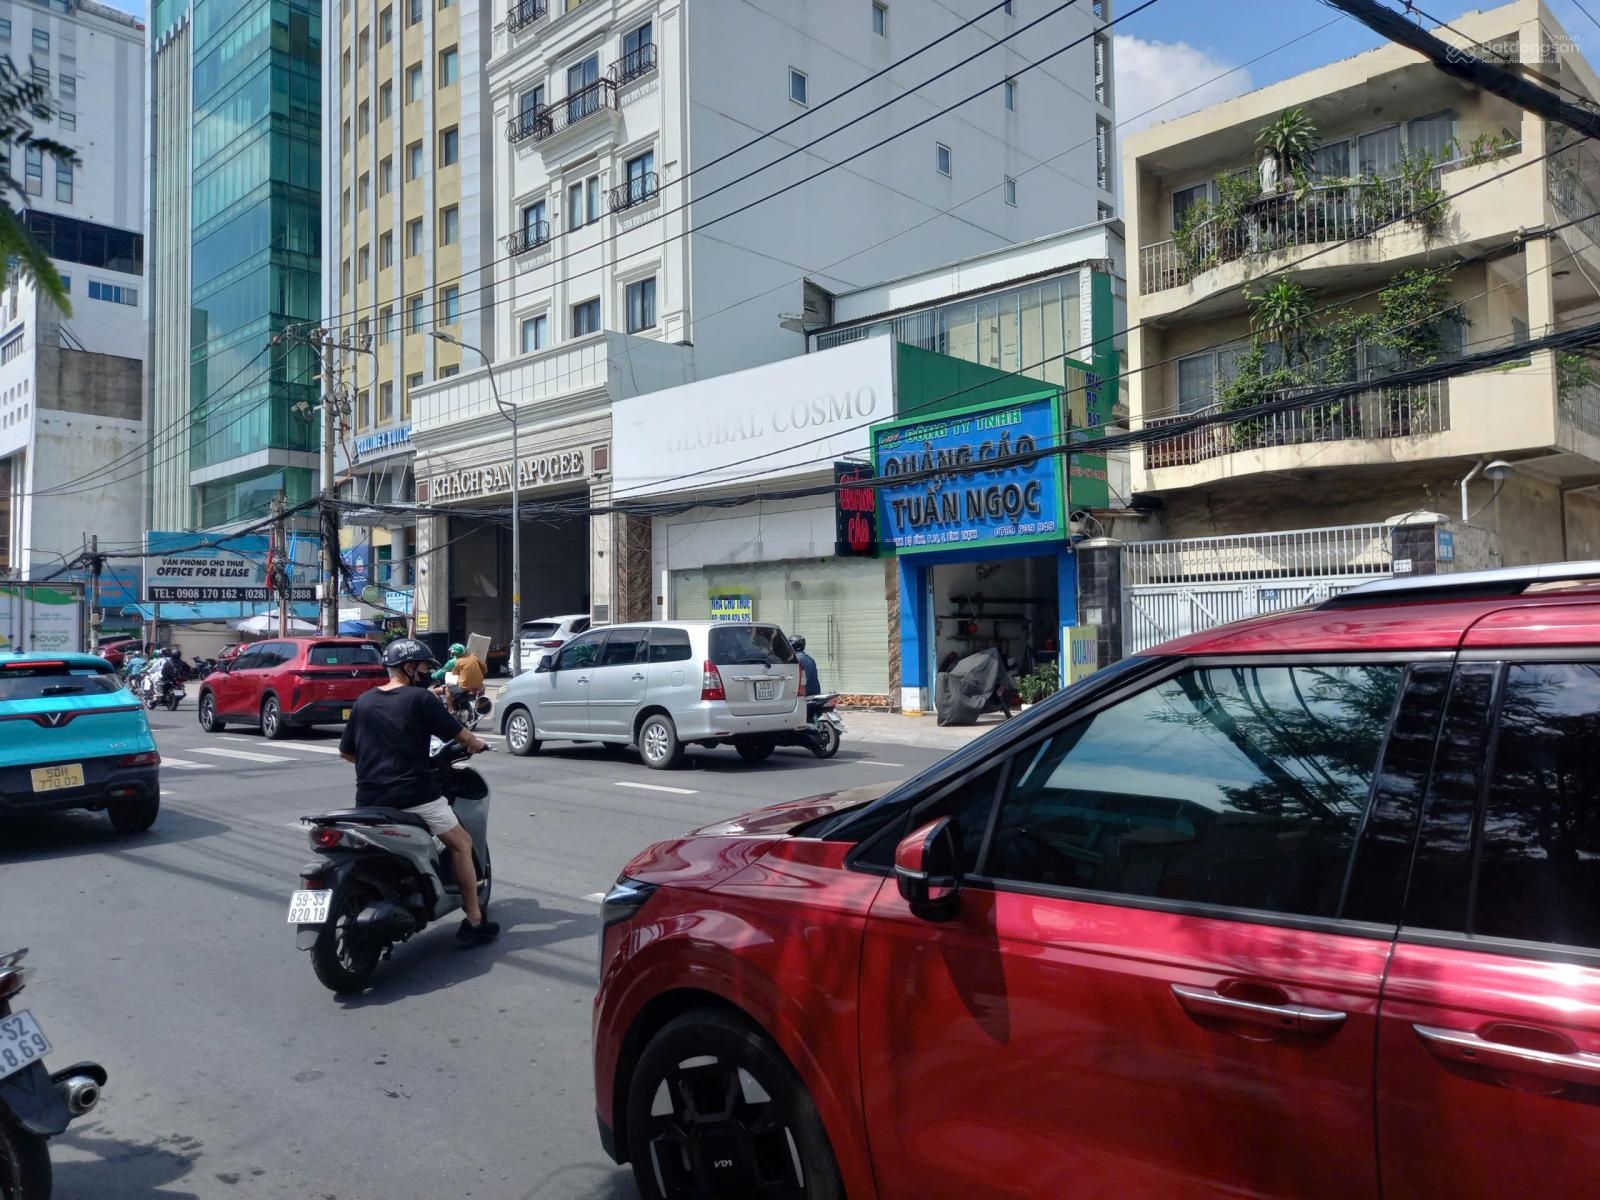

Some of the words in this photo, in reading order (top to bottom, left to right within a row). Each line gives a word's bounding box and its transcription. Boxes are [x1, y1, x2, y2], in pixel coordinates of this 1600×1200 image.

[772, 386, 876, 433] COSMO
[904, 422, 948, 443] CÔNG
[951, 418, 972, 435] TY
[977, 409, 1022, 431] TNHH
[980, 429, 1037, 474] CÁO
[432, 470, 482, 499] KHÁCH
[517, 450, 583, 487] APOGEE
[966, 479, 1040, 524] NGỌC
[156, 567, 194, 577] OFFICE
[195, 567, 218, 577] FOR
[219, 568, 249, 578] LEASE
[209, 559, 225, 567] CHO
[153, 588, 175, 599] TEL:
[176, 588, 200, 599] 0908
[202, 589, 219, 599] 170
[221, 589, 237, 599] 162
[245, 589, 267, 600] (028)
[292, 590, 311, 600] 2888
[296, 893, 326, 907] 59-S3
[290, 907, 326, 922] 820.18
